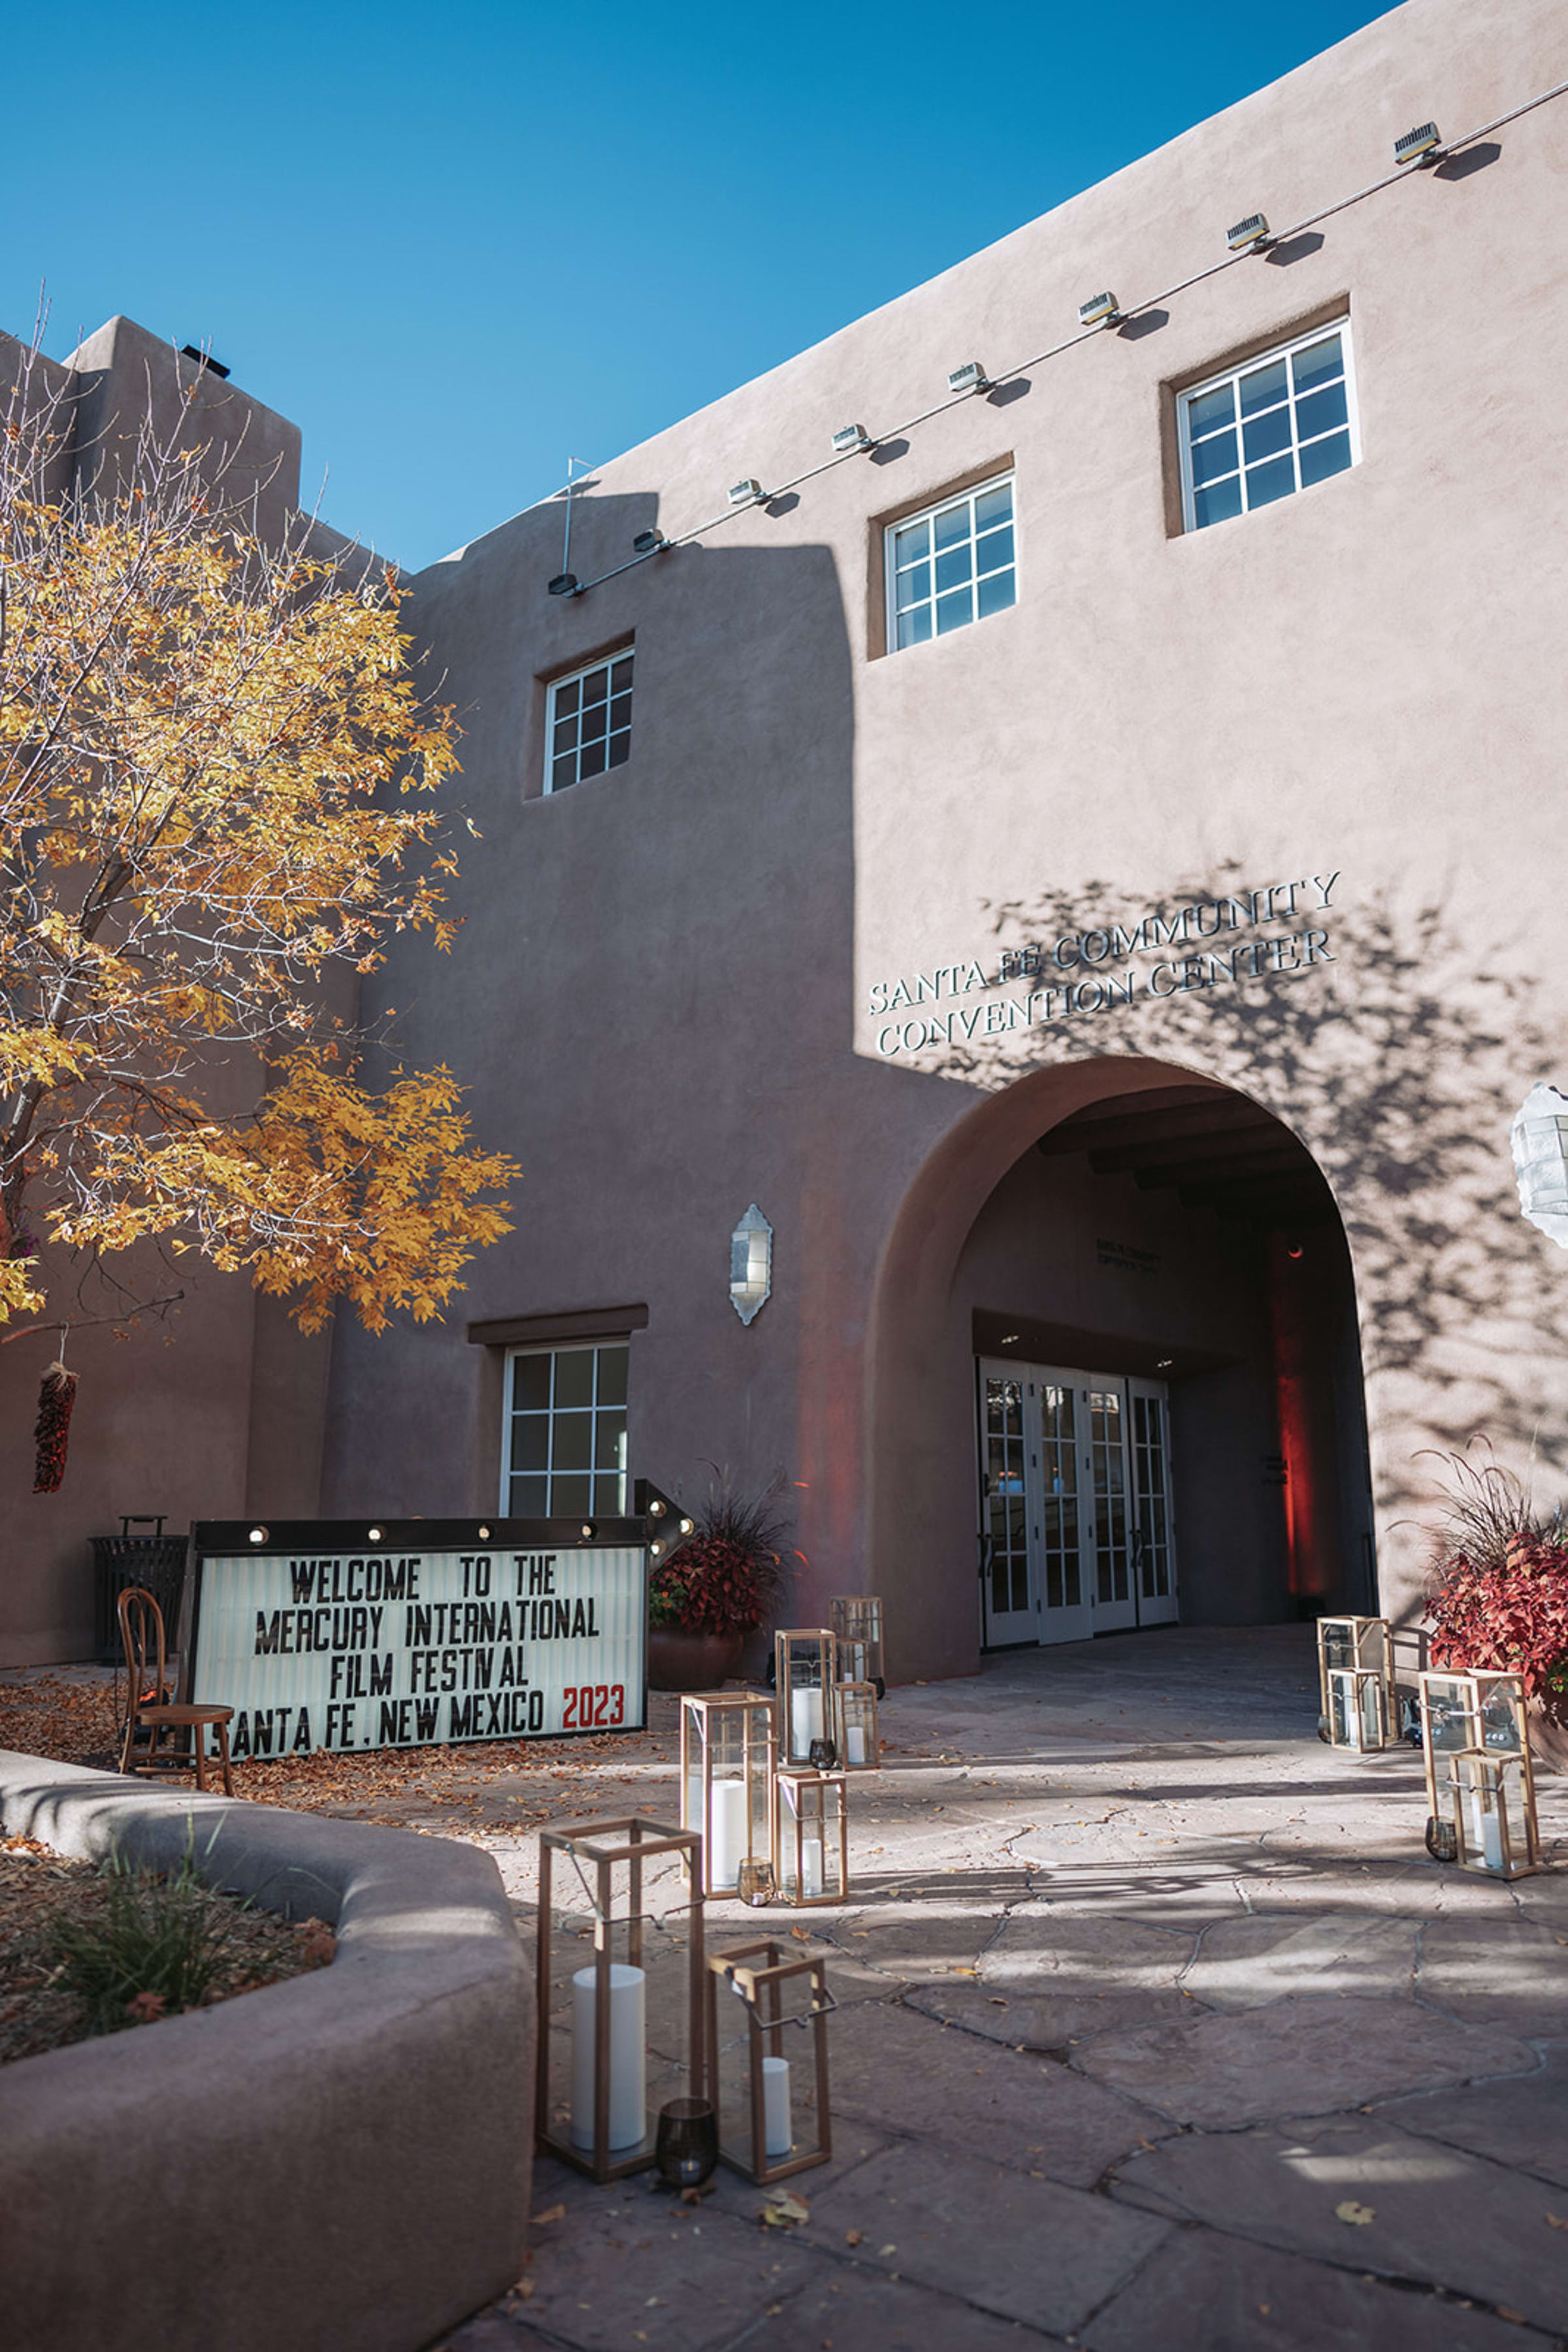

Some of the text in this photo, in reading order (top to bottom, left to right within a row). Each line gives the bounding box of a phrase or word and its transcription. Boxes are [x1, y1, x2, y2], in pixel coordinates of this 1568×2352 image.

[868, 870, 1341, 1015] SANTA FE COMMUNITY
[876, 929, 1337, 1057] CONVENTION CENTER
[290, 1555, 556, 1605] WELCOME TO THE
[254, 1597, 600, 1655] MERCURY INTERNATIONAL
[330, 1646, 529, 1700] FILM FESTIVAL
[378, 1697, 440, 1745] NEW
[449, 1690, 544, 1738] MEXICO
[562, 1684, 625, 1729] 2023
